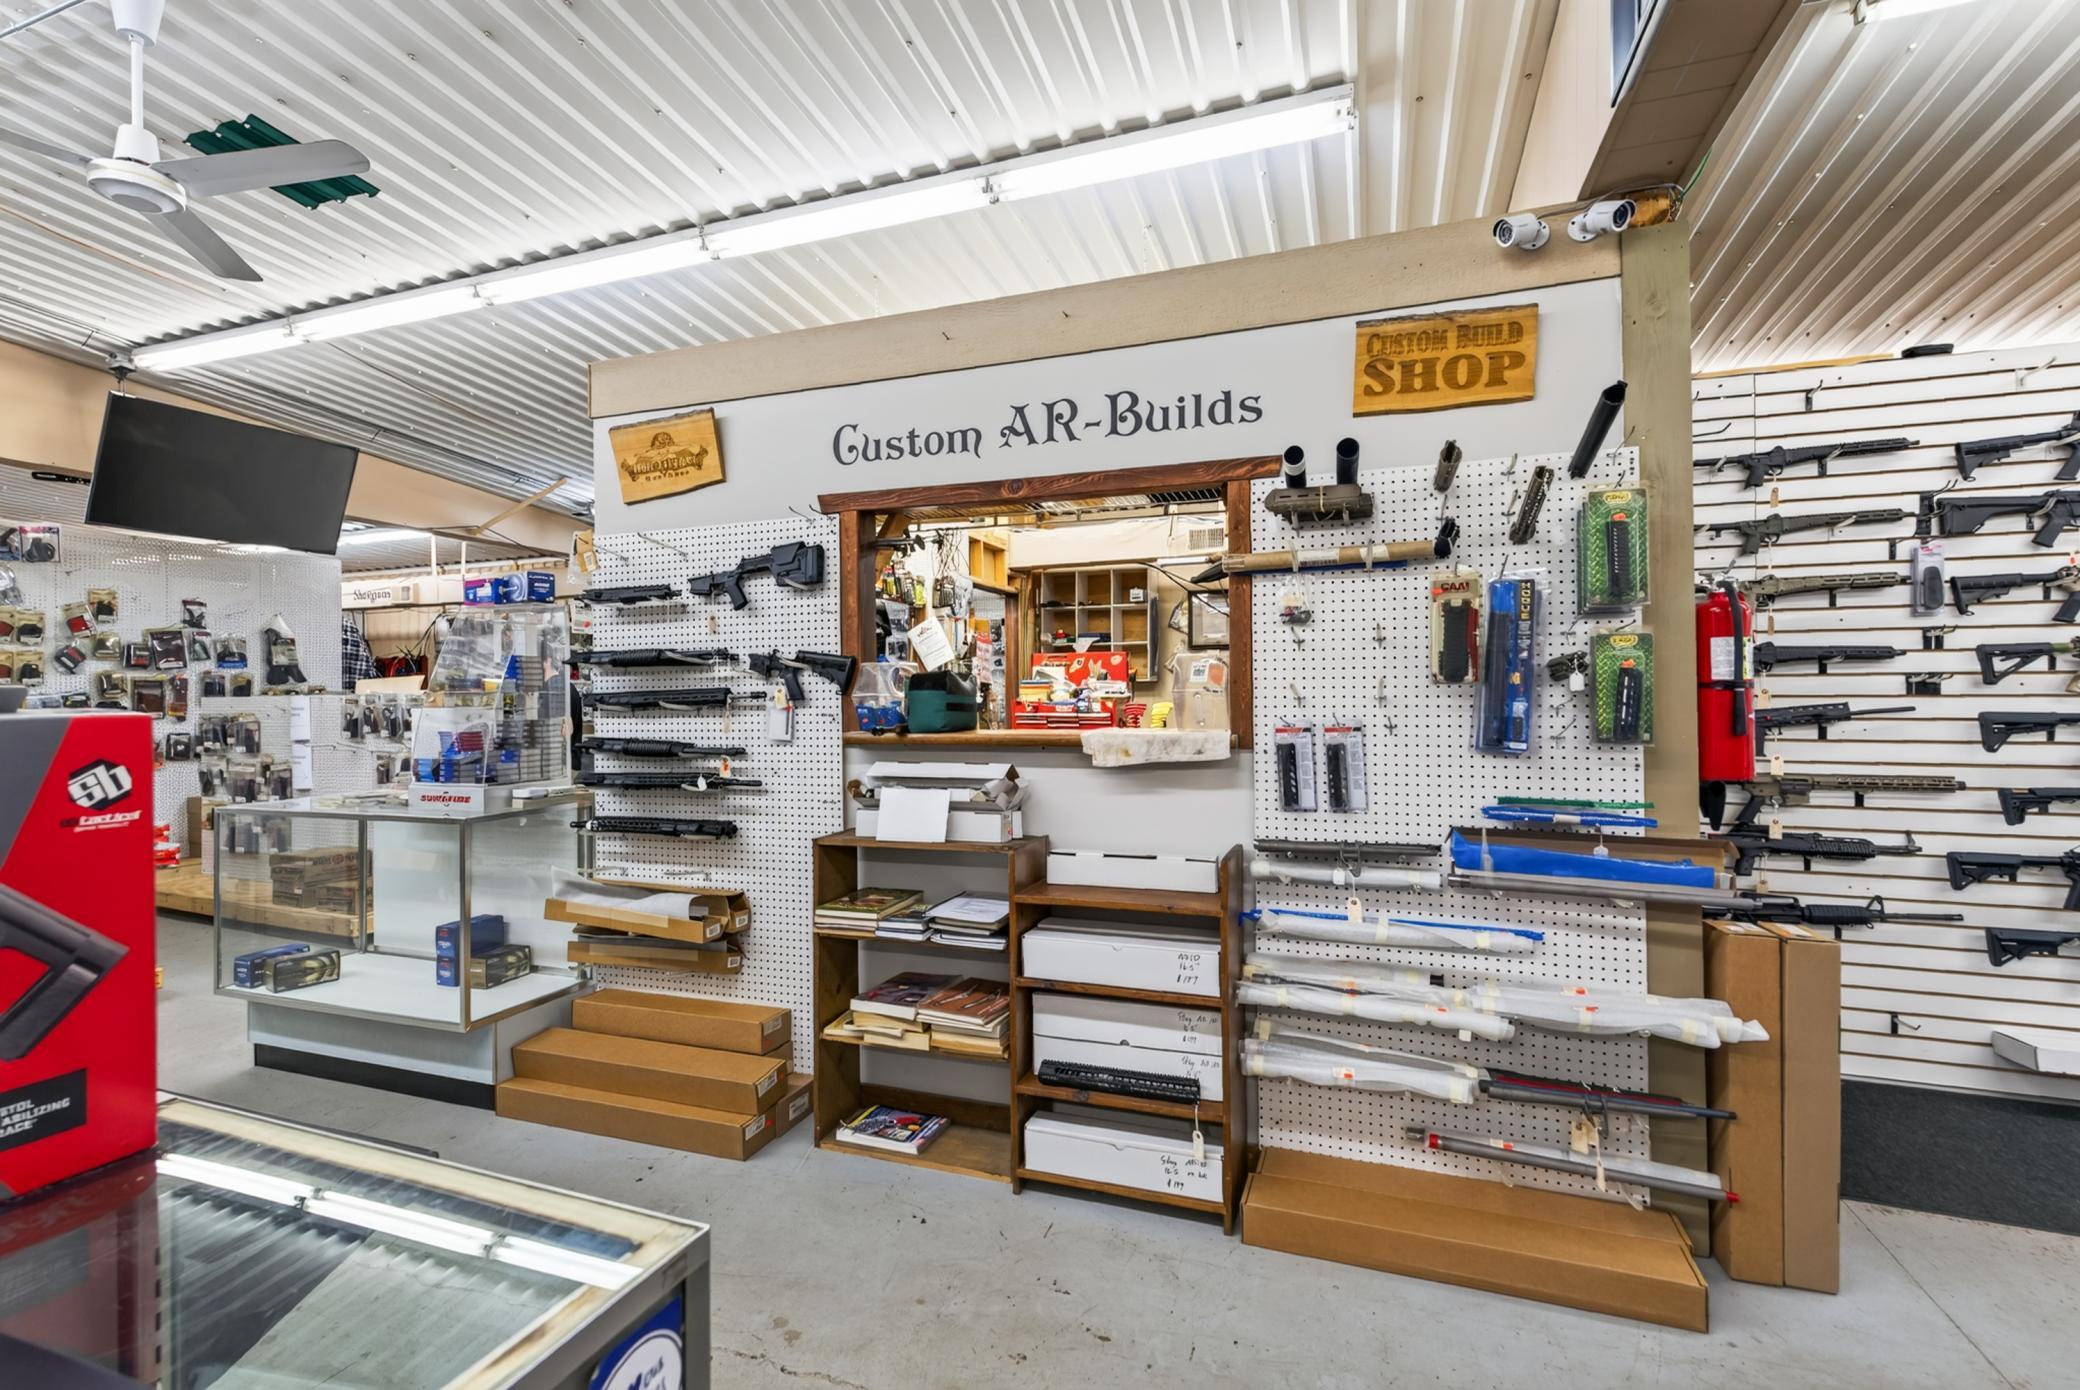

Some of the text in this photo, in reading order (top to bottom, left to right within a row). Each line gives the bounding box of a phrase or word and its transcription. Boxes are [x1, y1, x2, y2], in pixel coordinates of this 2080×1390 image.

[1363, 350, 1527, 397] SHOP
[832, 389, 1263, 466] Custom AR-Builds
